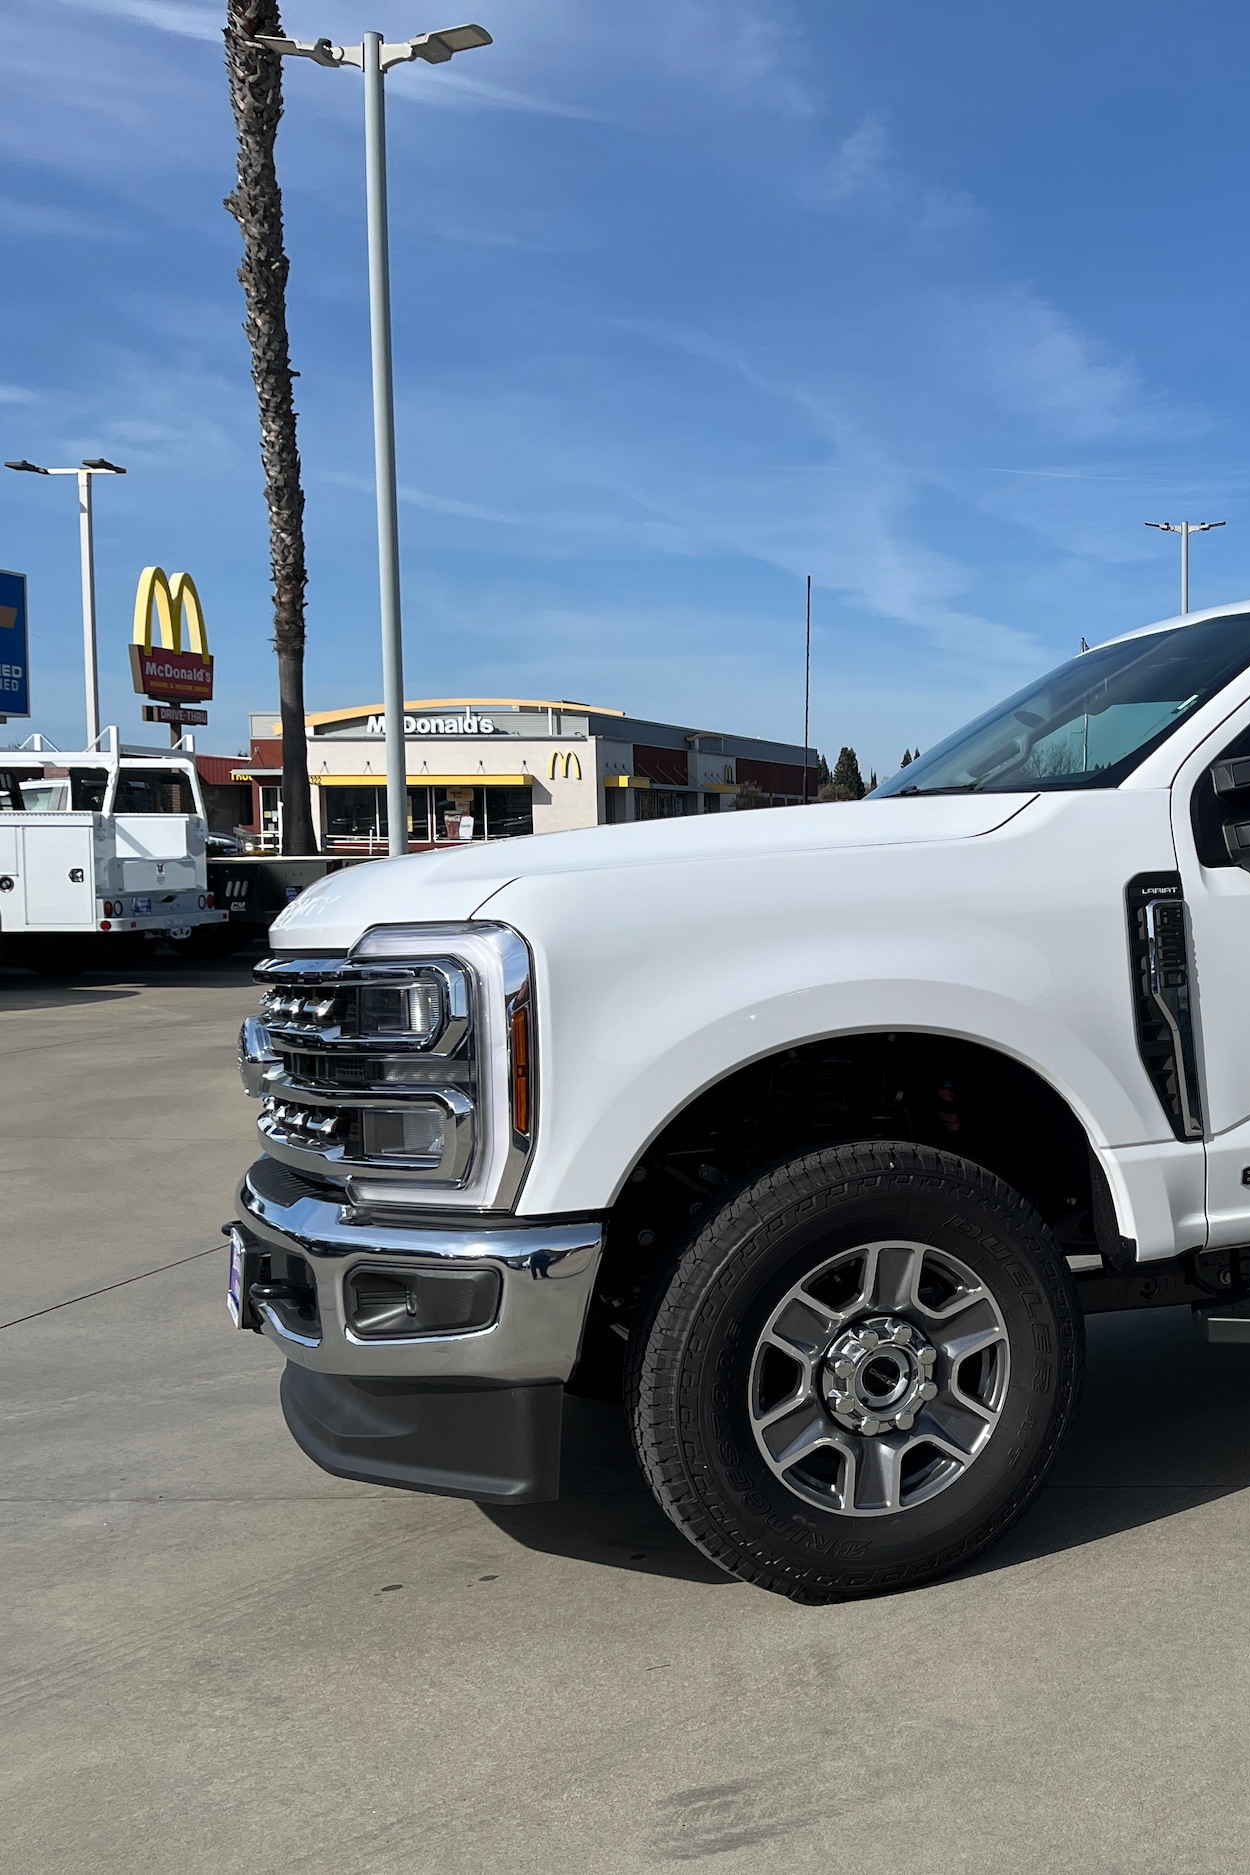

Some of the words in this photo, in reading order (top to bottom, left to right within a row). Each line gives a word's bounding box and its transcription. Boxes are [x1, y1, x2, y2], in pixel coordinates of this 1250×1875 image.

[145, 661, 211, 683] McDonald's
[160, 708, 207, 724] DRIVE-THRU
[366, 716, 494, 734] MDonald's
